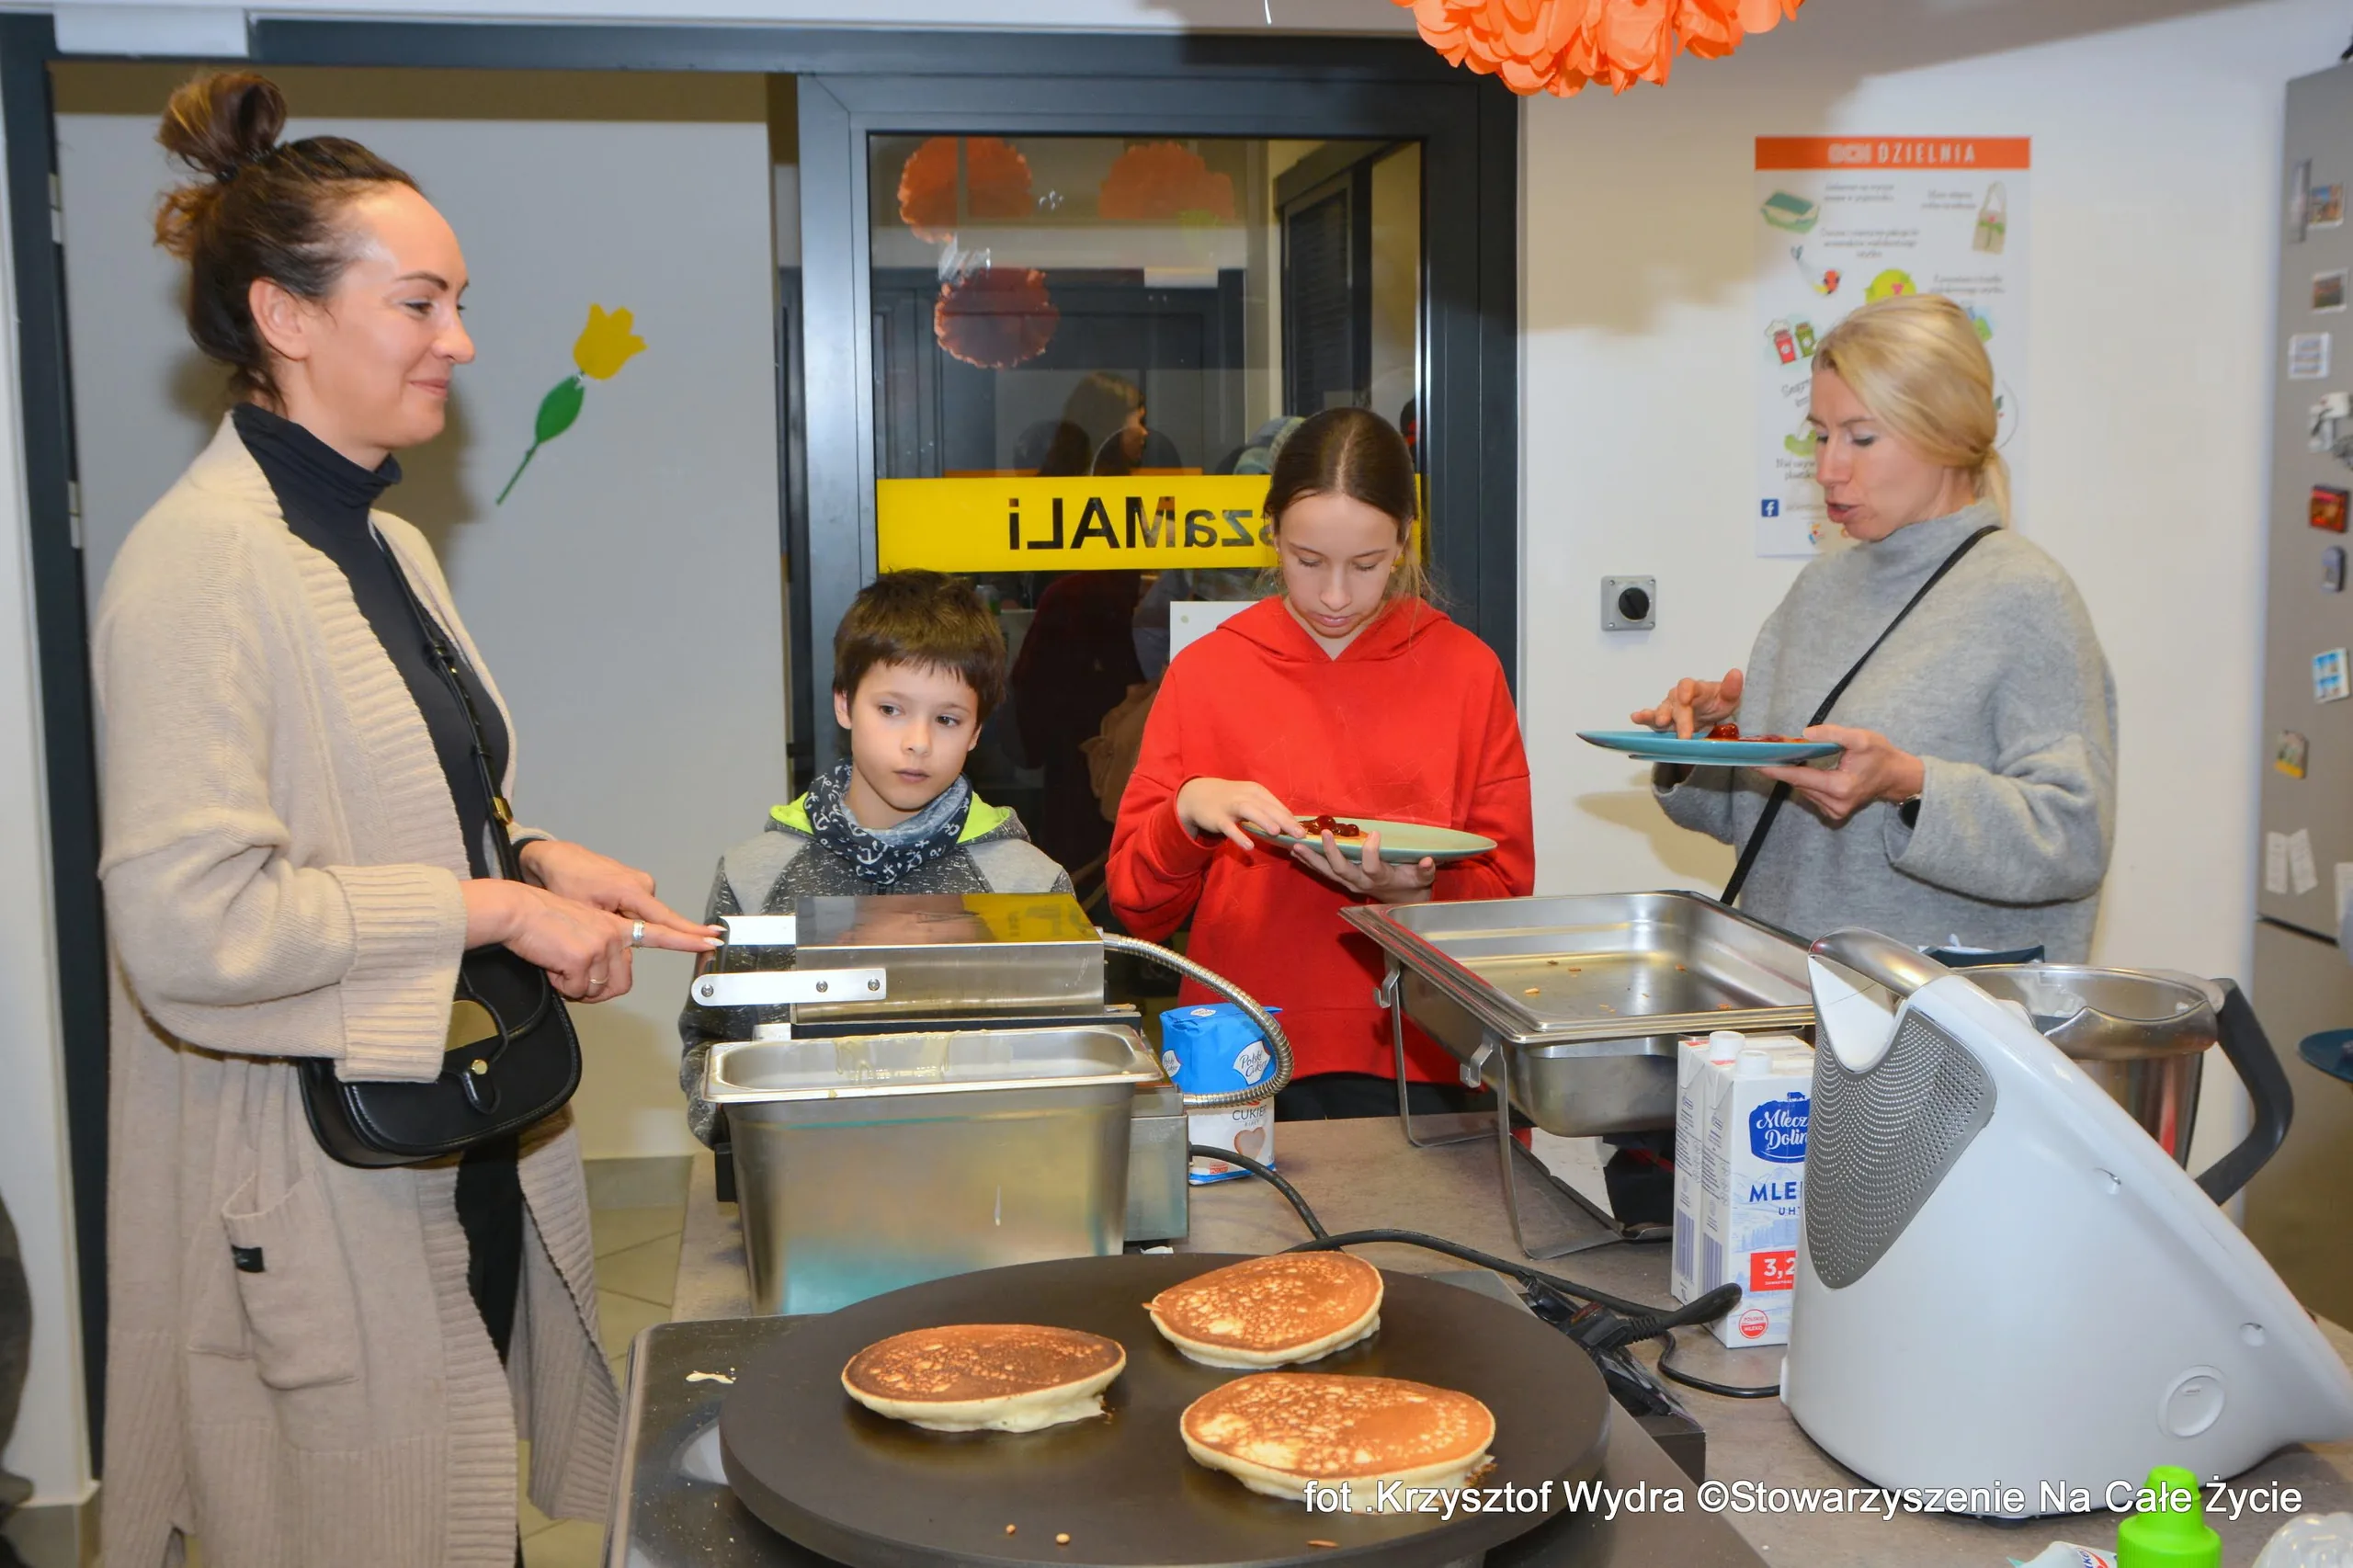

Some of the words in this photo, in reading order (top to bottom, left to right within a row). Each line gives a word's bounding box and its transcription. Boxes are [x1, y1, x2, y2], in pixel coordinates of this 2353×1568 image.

[1877, 142, 1975, 165] DZIELNIA
[1756, 1108, 1809, 1130] Mlecz
[1764, 1129, 1808, 1151] Dolin
[1748, 1181, 1802, 1202] MLE
[1779, 1206, 1801, 1216] UH
[1763, 1256, 1796, 1279] 3,2
